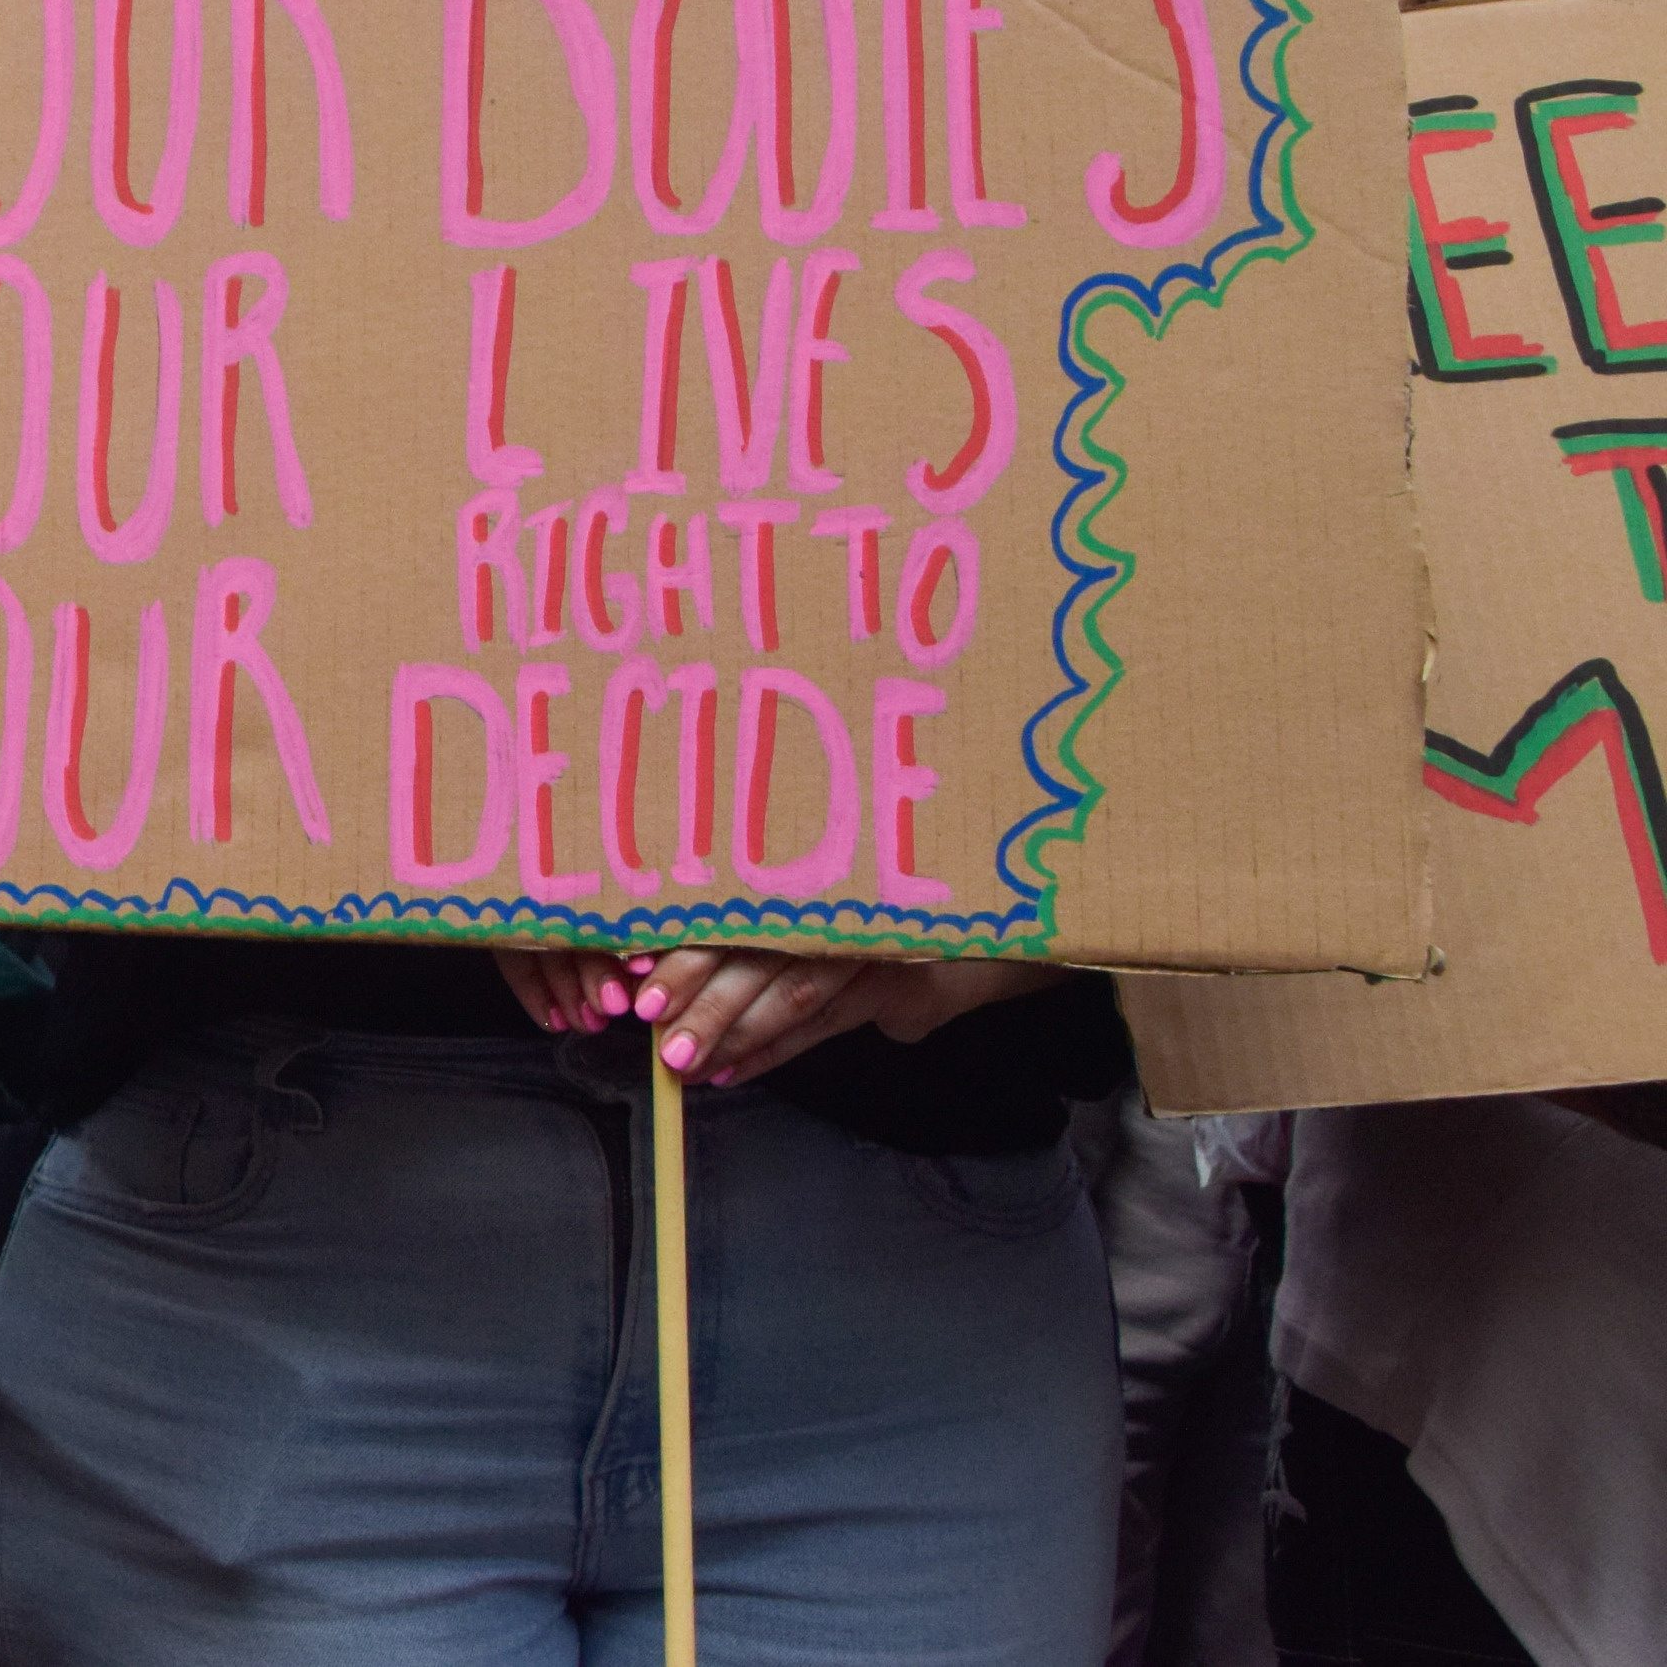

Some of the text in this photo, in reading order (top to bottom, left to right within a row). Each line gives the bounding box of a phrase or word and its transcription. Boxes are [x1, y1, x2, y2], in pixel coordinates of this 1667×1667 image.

[466, 247, 1019, 516] LIVES
[456, 484, 800, 657] RIGHT
[809, 505, 980, 670] TO
[389, 653, 952, 907] DECIDE
